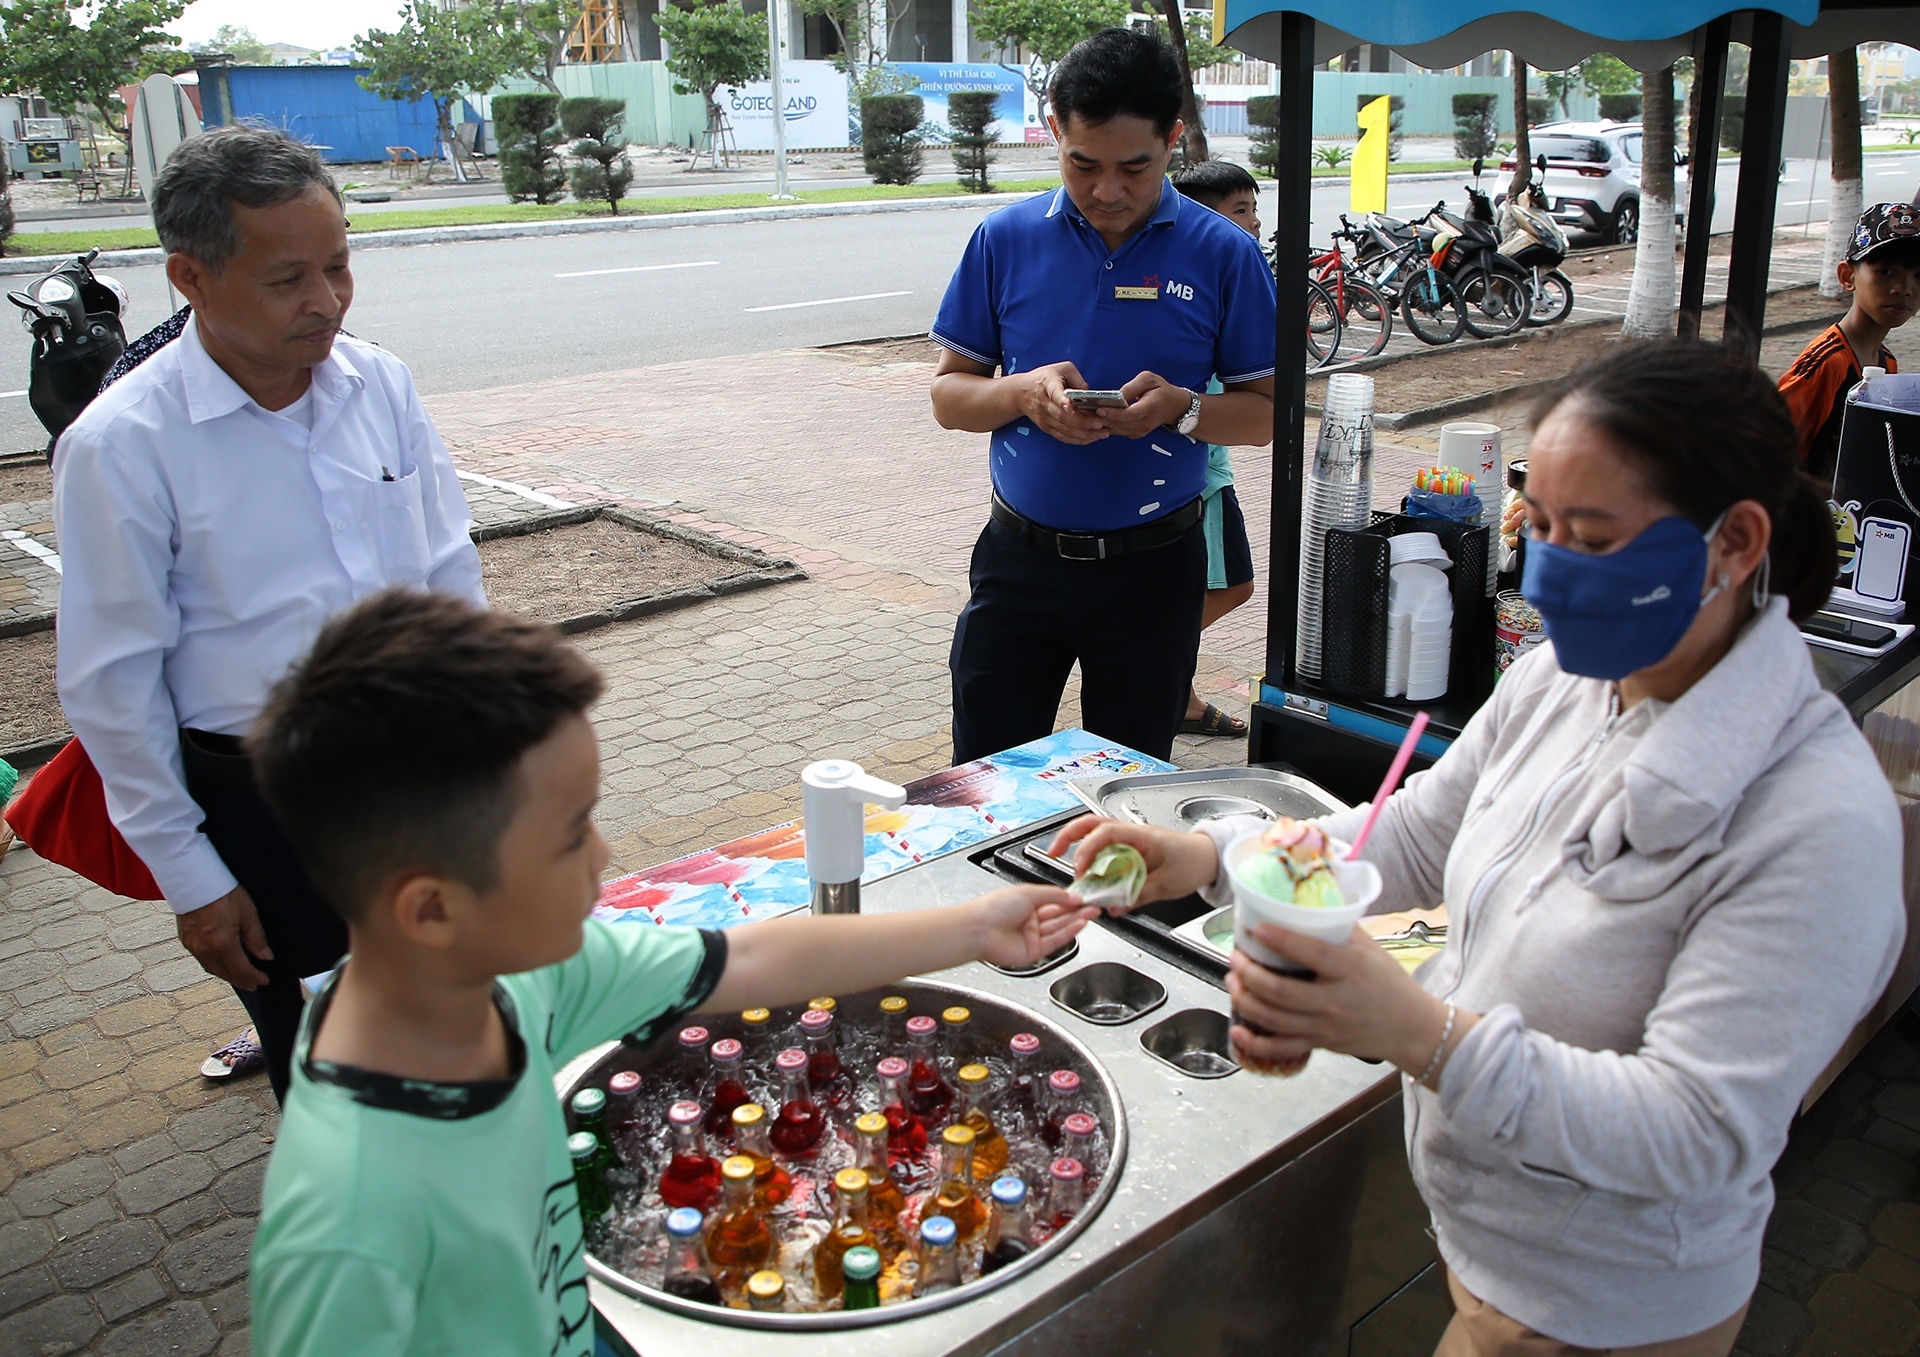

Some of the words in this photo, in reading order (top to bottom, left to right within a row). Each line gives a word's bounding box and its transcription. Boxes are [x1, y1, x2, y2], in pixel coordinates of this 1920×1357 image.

[980, 70, 996, 79] CAO
[920, 82, 942, 91] THIÊN
[1166, 280, 1194, 300] MB
